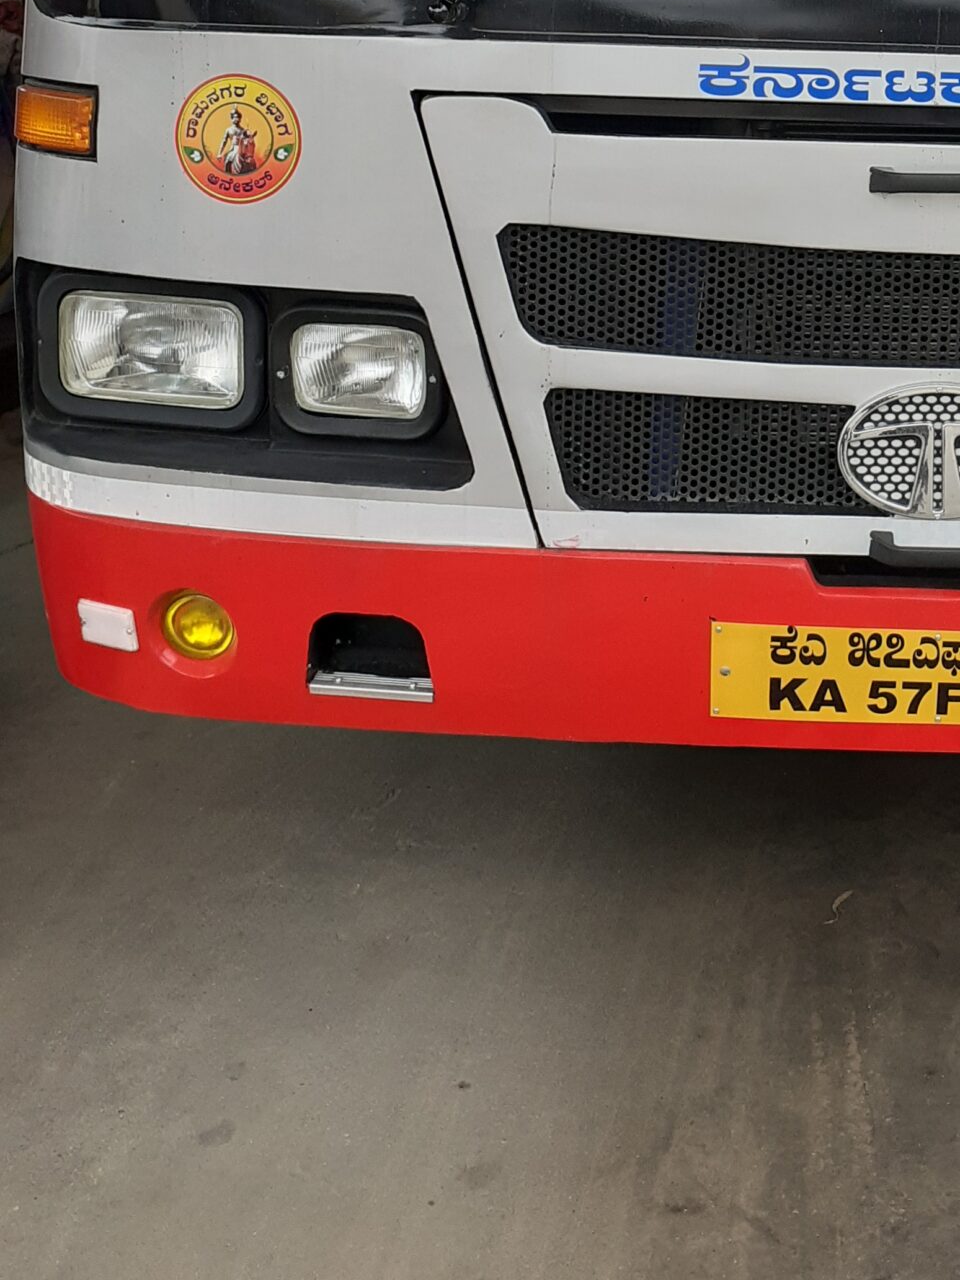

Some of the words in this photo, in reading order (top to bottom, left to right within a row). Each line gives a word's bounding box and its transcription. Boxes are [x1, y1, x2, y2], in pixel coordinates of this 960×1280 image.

[186, 83, 247, 138] ರಾಮನಗರ
[255, 93, 292, 136] ವಿಭಾಗ
[769, 677, 848, 713] KA
